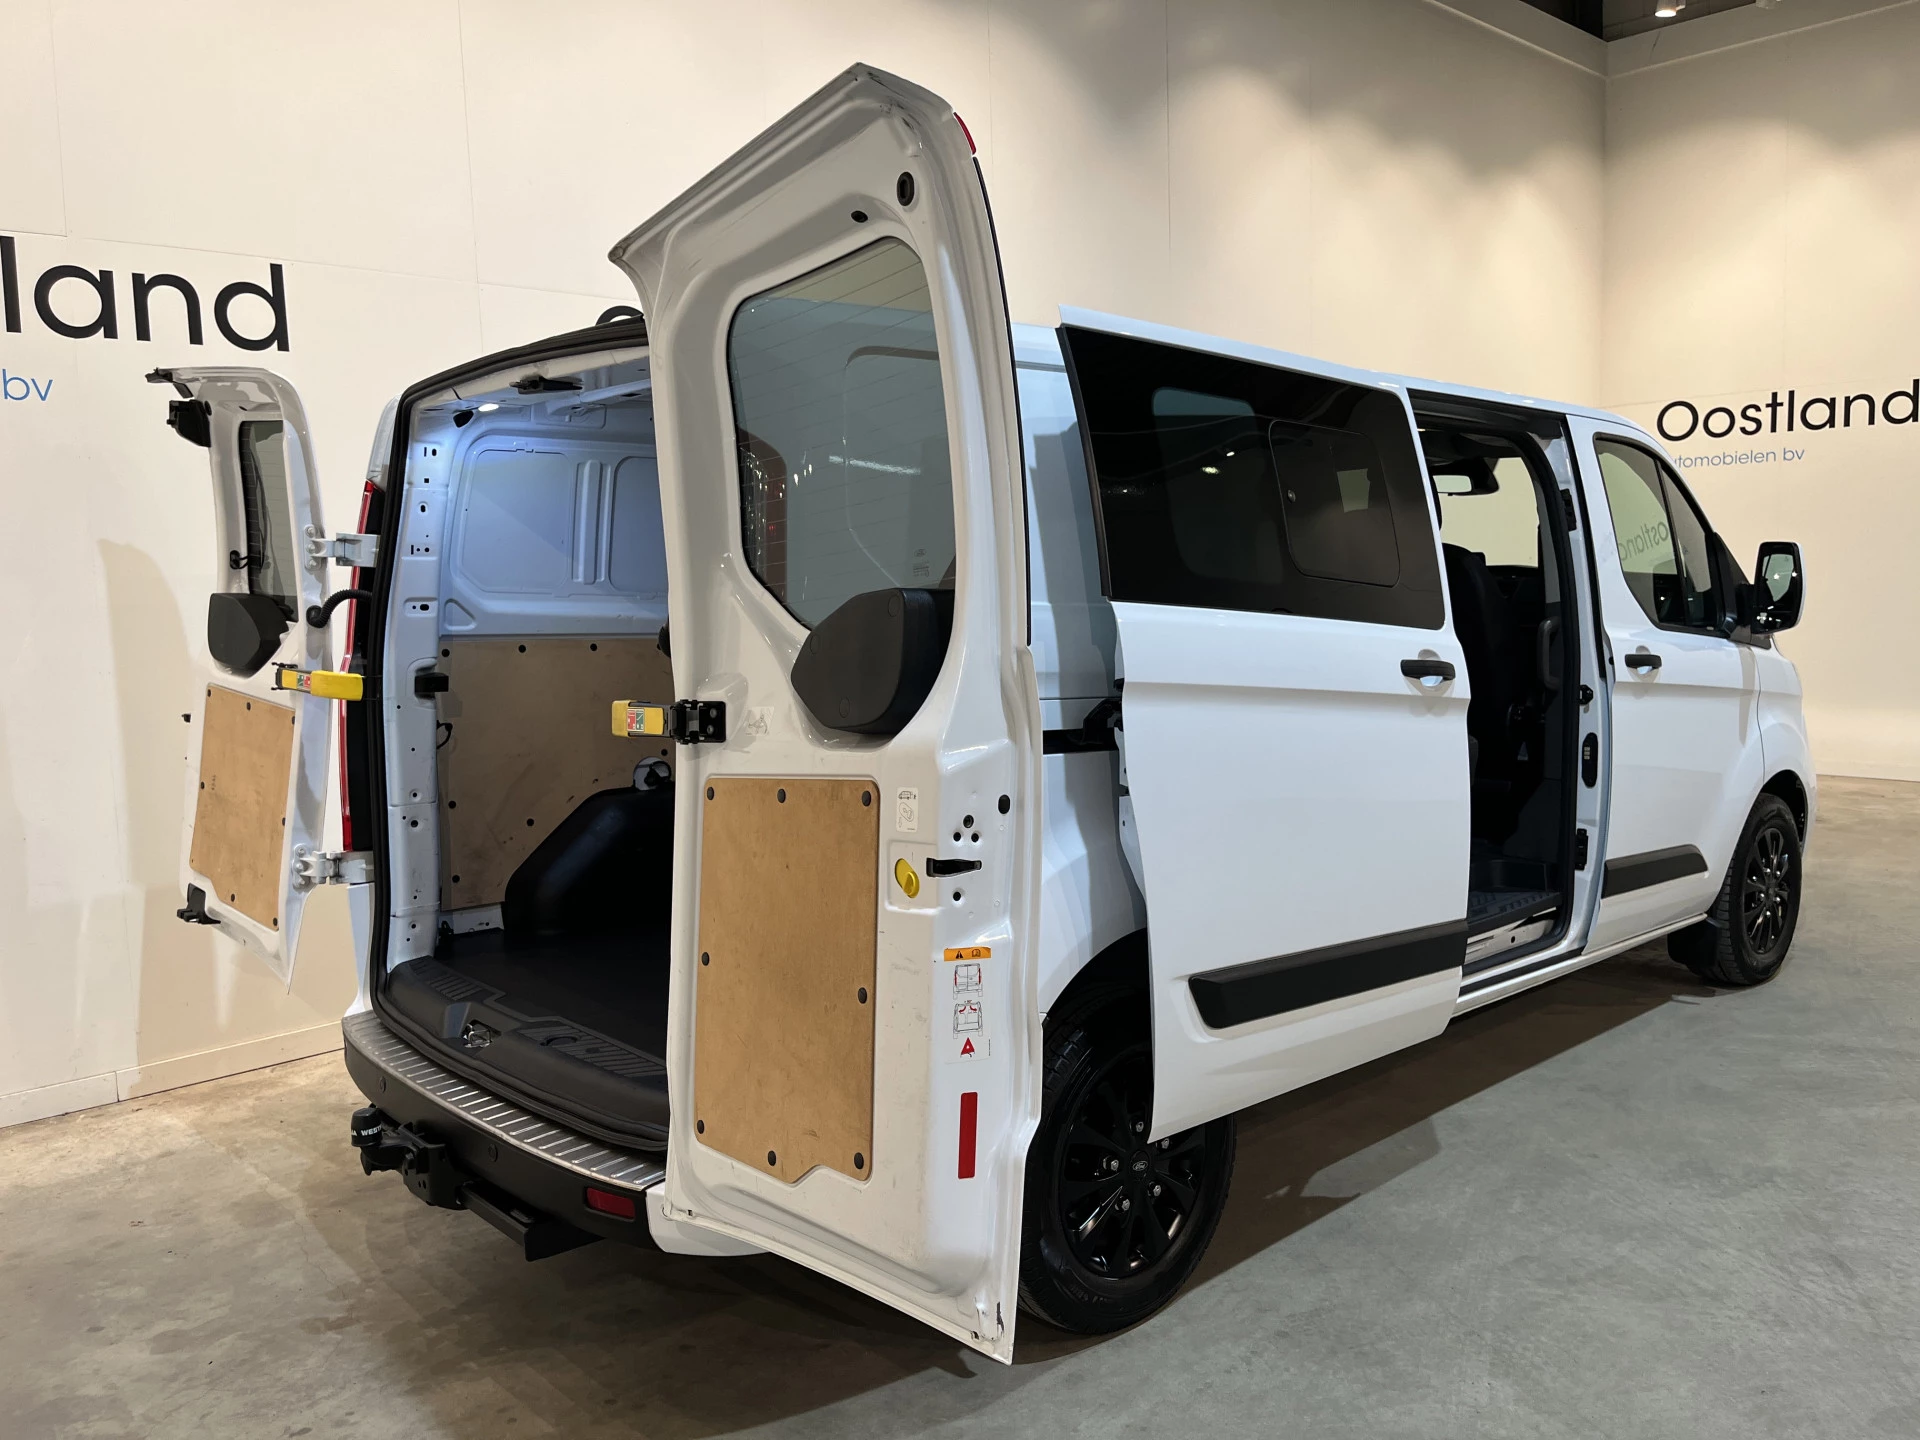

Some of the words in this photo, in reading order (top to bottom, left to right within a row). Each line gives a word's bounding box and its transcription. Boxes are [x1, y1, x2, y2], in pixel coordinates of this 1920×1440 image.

[0, 235, 290, 352] land
[2, 368, 53, 401] bv
[1657, 378, 1920, 442] Oostland
[1783, 447, 1805, 462] bv
